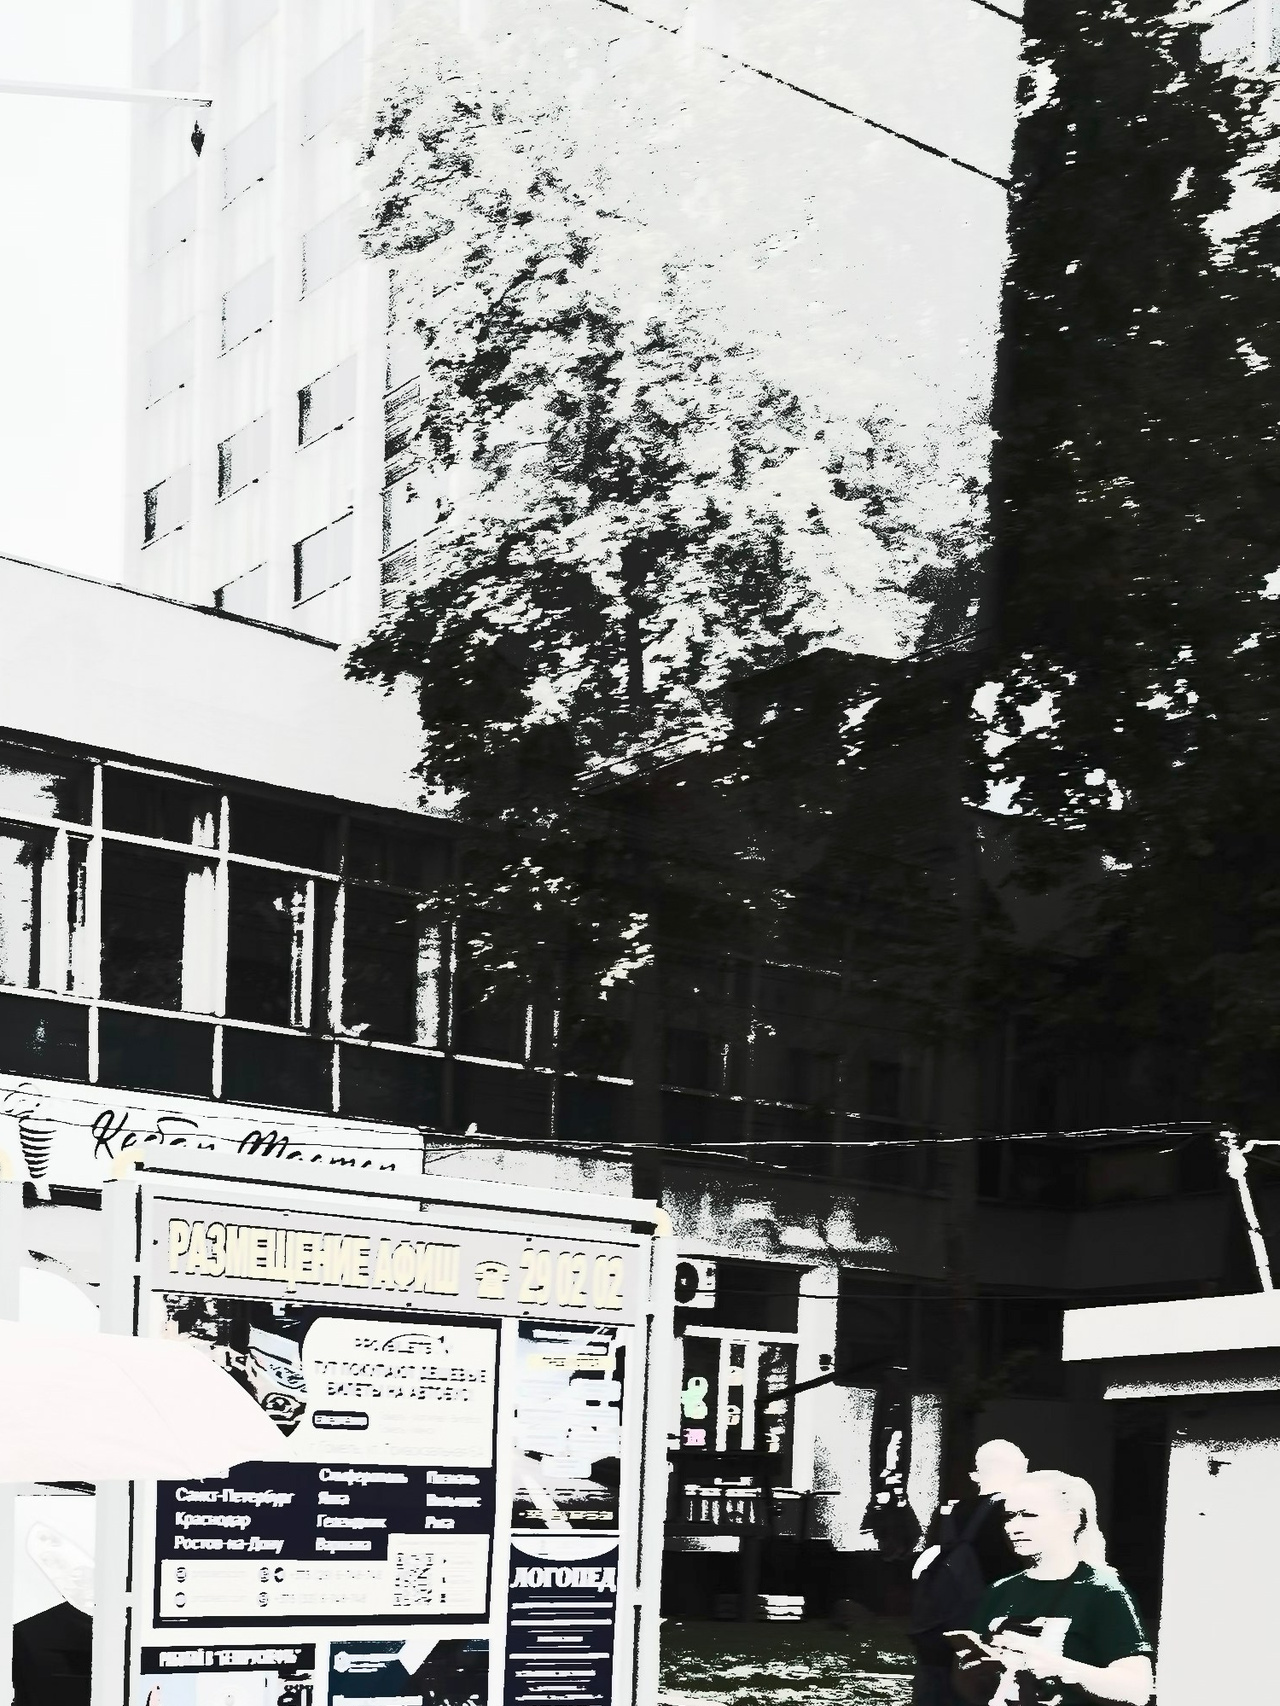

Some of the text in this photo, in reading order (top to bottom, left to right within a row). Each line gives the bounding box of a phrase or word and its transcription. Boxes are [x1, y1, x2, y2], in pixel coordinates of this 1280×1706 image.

[168, 1218, 624, 1310] РАЗМЕЩЕНИЕ АФИШ 29 02 02
[175, 1486, 296, 1507] Санкт-Петербург
[175, 1511, 252, 1530] Краснодар
[173, 1535, 285, 1554] Ростов-на-Дону
[509, 1566, 617, 1592] ЛОГОПЕД
